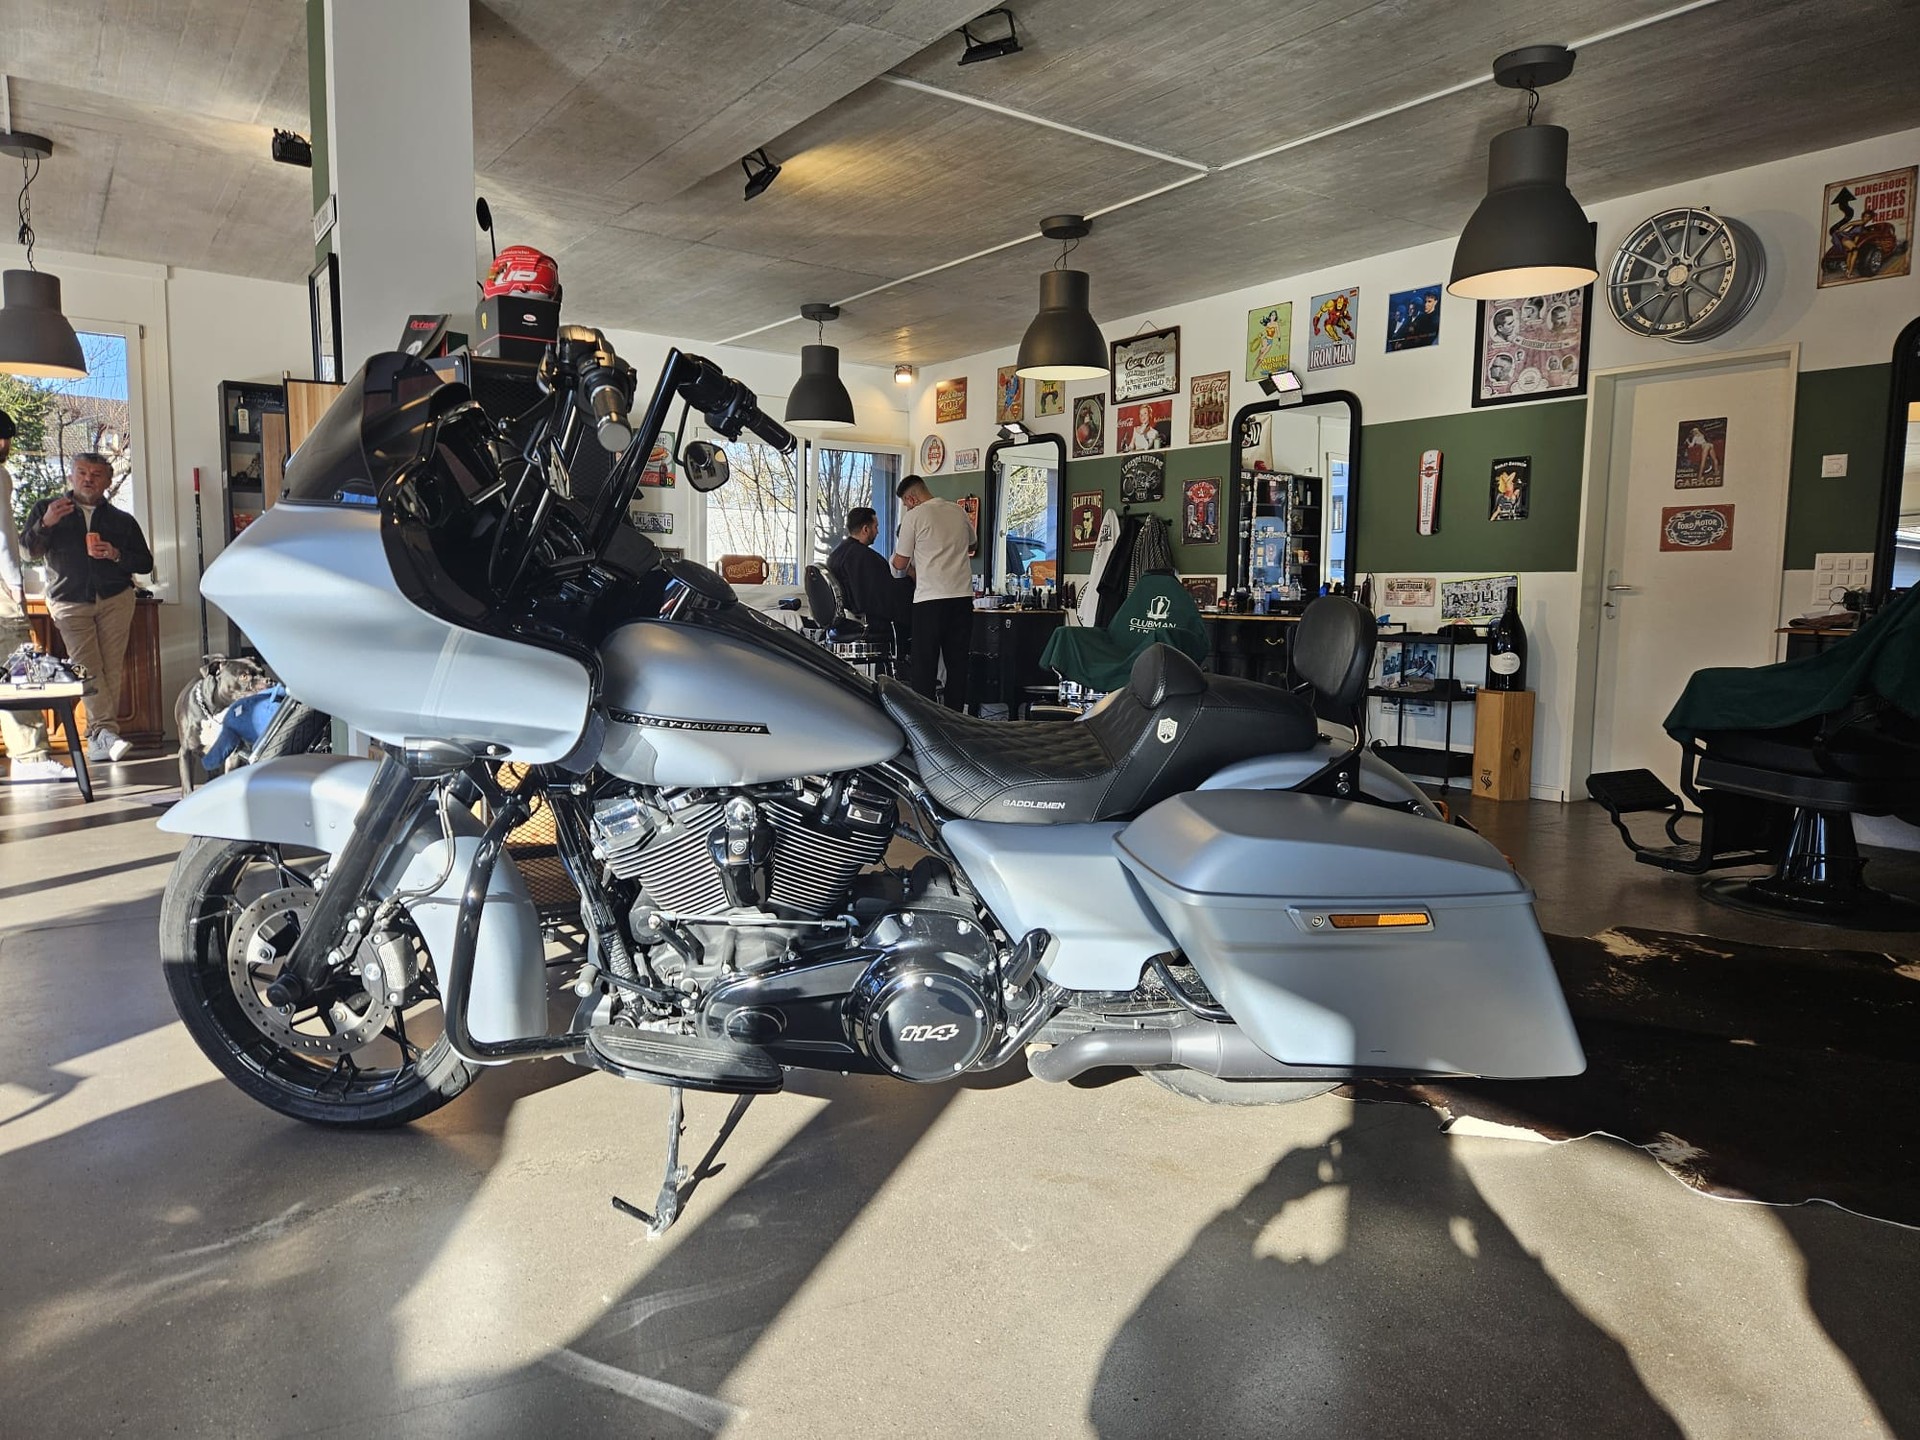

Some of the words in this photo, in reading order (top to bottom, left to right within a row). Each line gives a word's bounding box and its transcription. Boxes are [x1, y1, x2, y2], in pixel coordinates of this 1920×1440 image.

[1855, 177, 1907, 196] DANGEROUS
[1864, 189, 1906, 212] CURVES
[1872, 208, 1905, 223] AHEAD
[1309, 347, 1332, 370] IRON
[1333, 343, 1354, 365] MAN
[1143, 380, 1164, 389] WORLD
[1675, 477, 1721, 487] GARAGE
[1130, 617, 1176, 628] CLUBMAN
[615, 713, 761, 733] HARLEY-DAVIDSON
[1002, 799, 1065, 810] SADDLEMEN
[900, 1023, 959, 1042] 114
